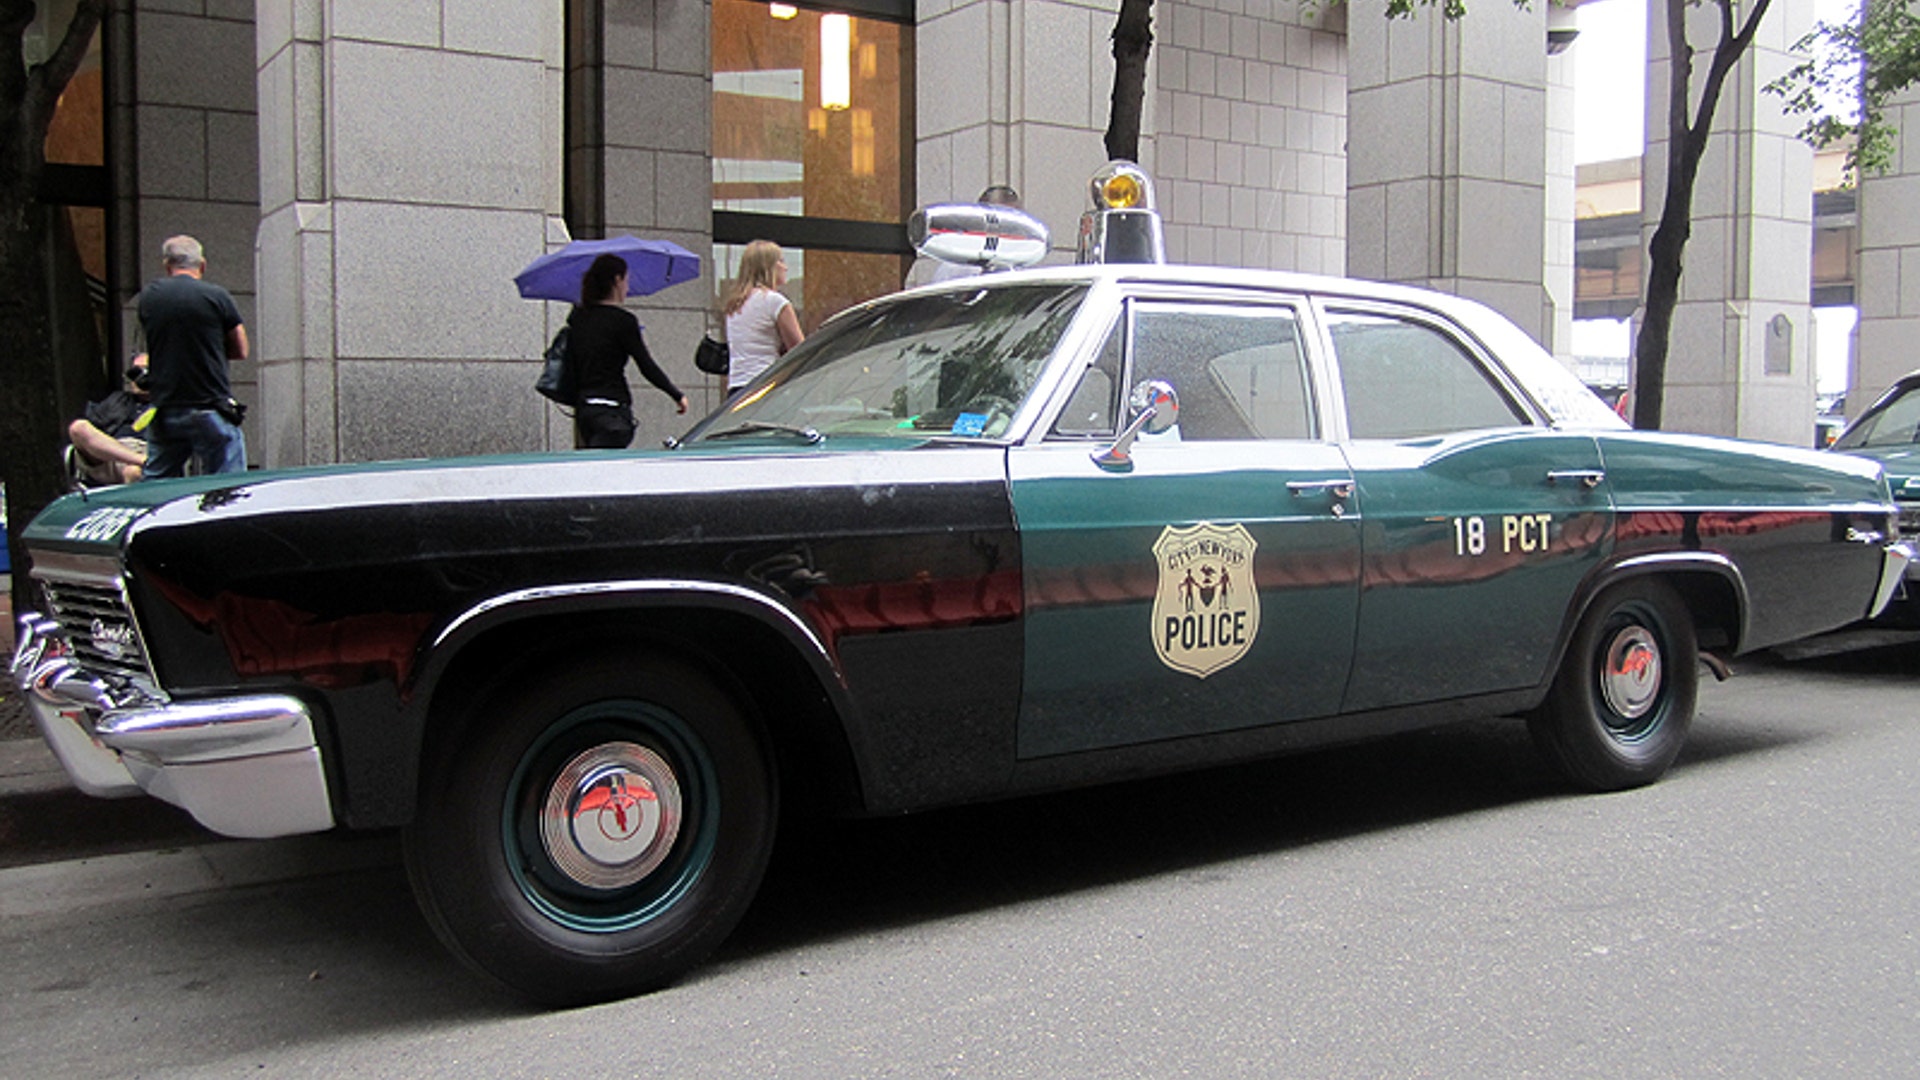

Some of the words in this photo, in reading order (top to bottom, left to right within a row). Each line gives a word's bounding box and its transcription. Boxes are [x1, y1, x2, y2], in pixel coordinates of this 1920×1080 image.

[1198, 540, 1219, 555] NEW
[1453, 517, 1486, 556] 18
[1502, 513, 1552, 553] PCT
[1165, 611, 1246, 652] POLICE
